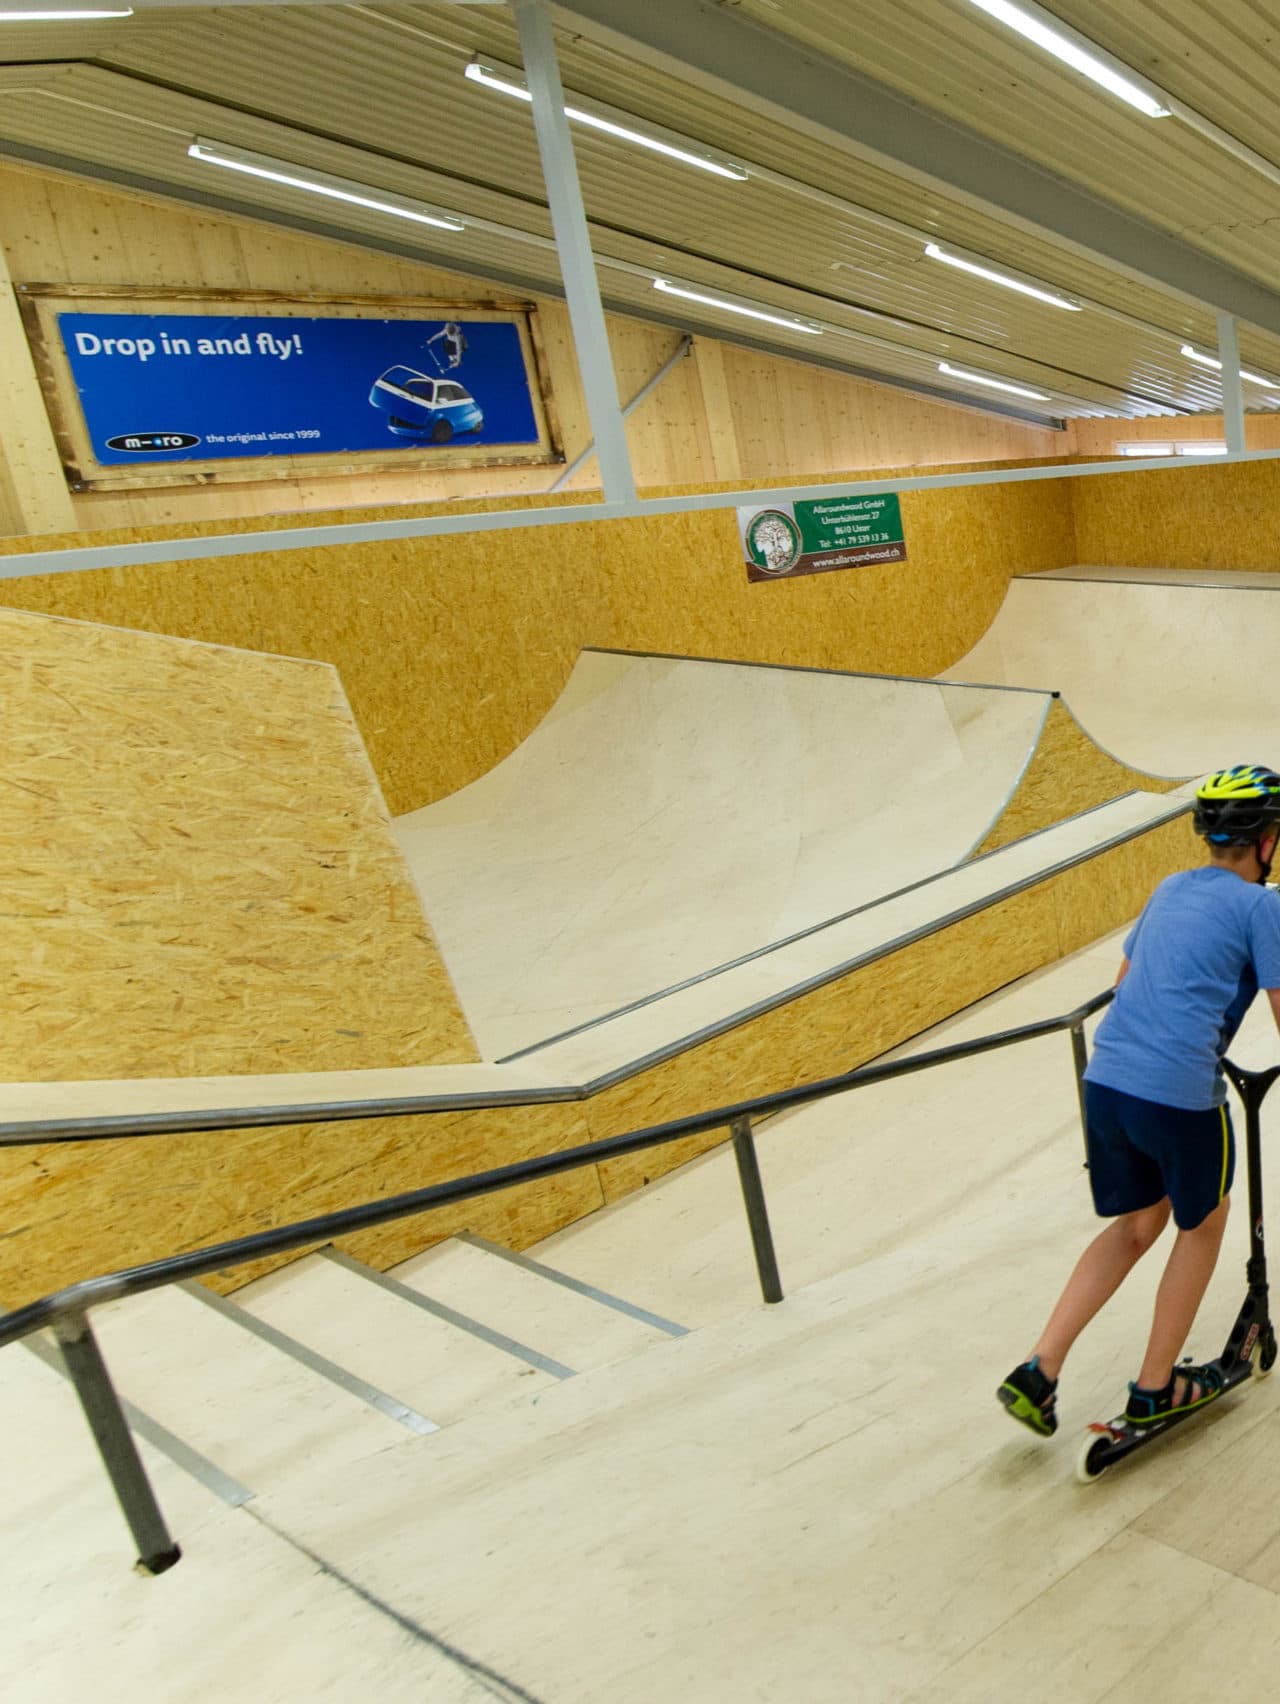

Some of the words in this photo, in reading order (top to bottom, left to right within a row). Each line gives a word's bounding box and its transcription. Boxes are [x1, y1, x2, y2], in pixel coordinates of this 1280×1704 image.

[74, 332, 156, 362] Drop
[160, 332, 191, 355] in
[197, 333, 252, 355] and
[256, 332, 303, 361] fly!
[206, 434, 225, 444] the
[226, 432, 268, 445] original
[268, 431, 295, 442] since
[296, 429, 321, 440] 1999
[864, 500, 885, 509] GmbH
